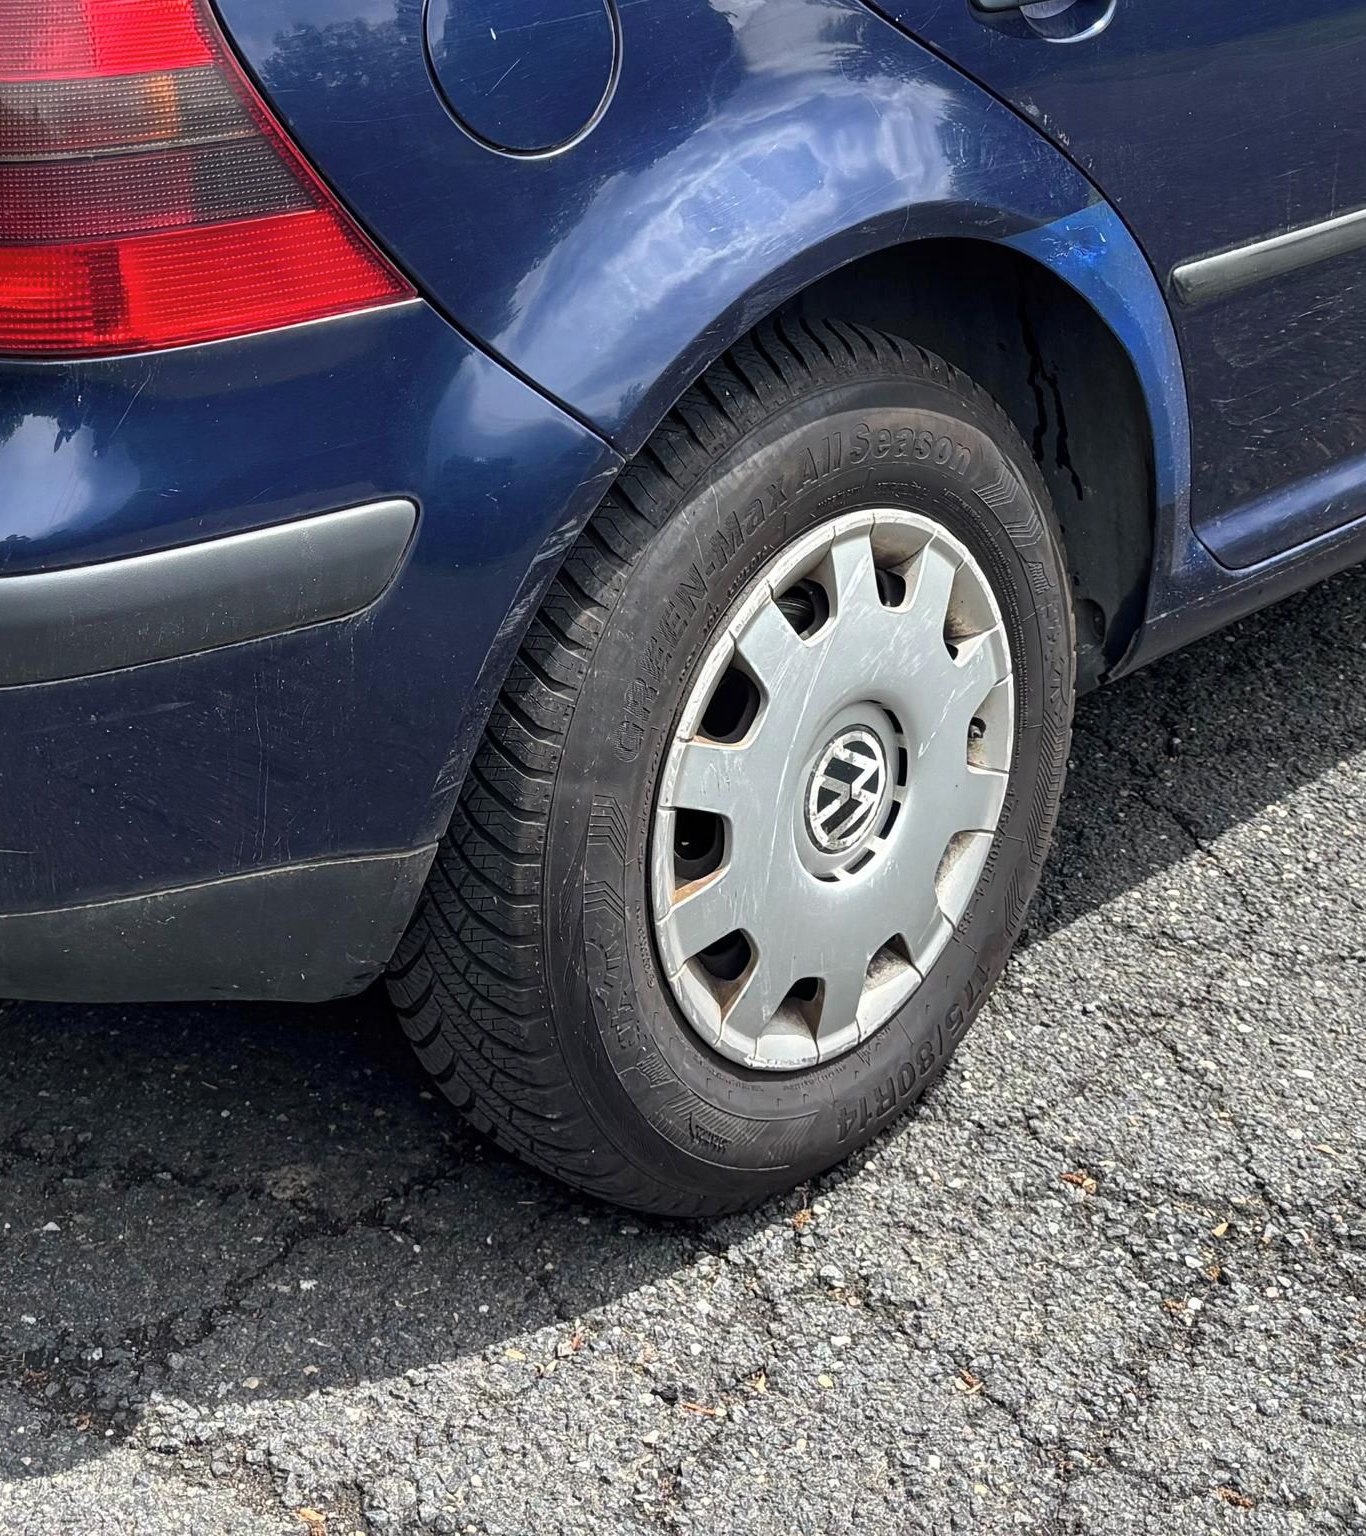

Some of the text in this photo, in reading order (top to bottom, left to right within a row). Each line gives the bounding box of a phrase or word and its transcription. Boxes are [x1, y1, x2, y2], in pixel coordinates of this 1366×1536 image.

[795, 431, 842, 495] All
[849, 422, 973, 476] Season
[836, 963, 992, 1144] 175/80R14
